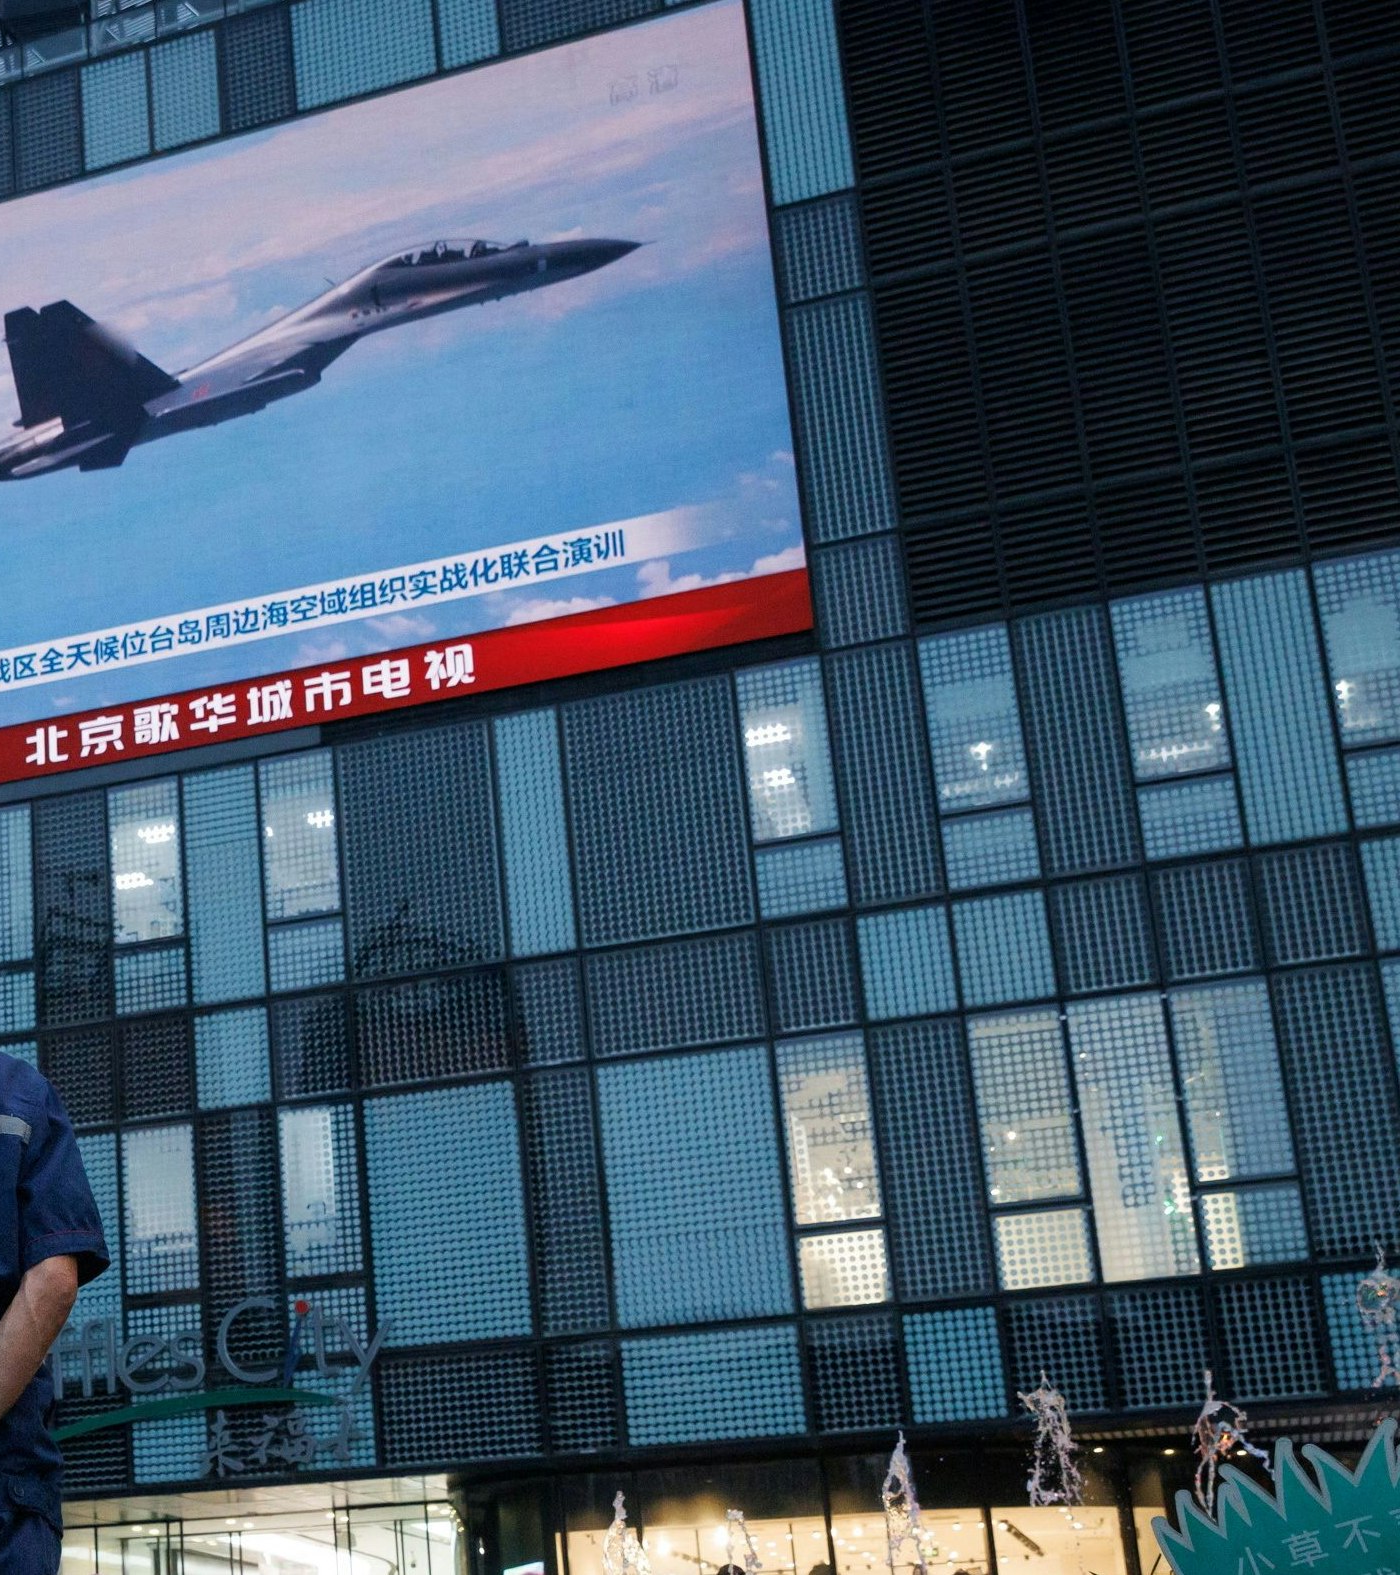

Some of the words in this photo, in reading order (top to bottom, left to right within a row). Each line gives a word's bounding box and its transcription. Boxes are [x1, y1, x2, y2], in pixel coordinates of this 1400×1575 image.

[25, 643, 476, 767] 北京歌华城市电视
[52, 1317, 206, 1399] ffles
[217, 1296, 392, 1395] City
[199, 1406, 367, 1478] 来福士
[1238, 1507, 1400, 1575] 小草不
